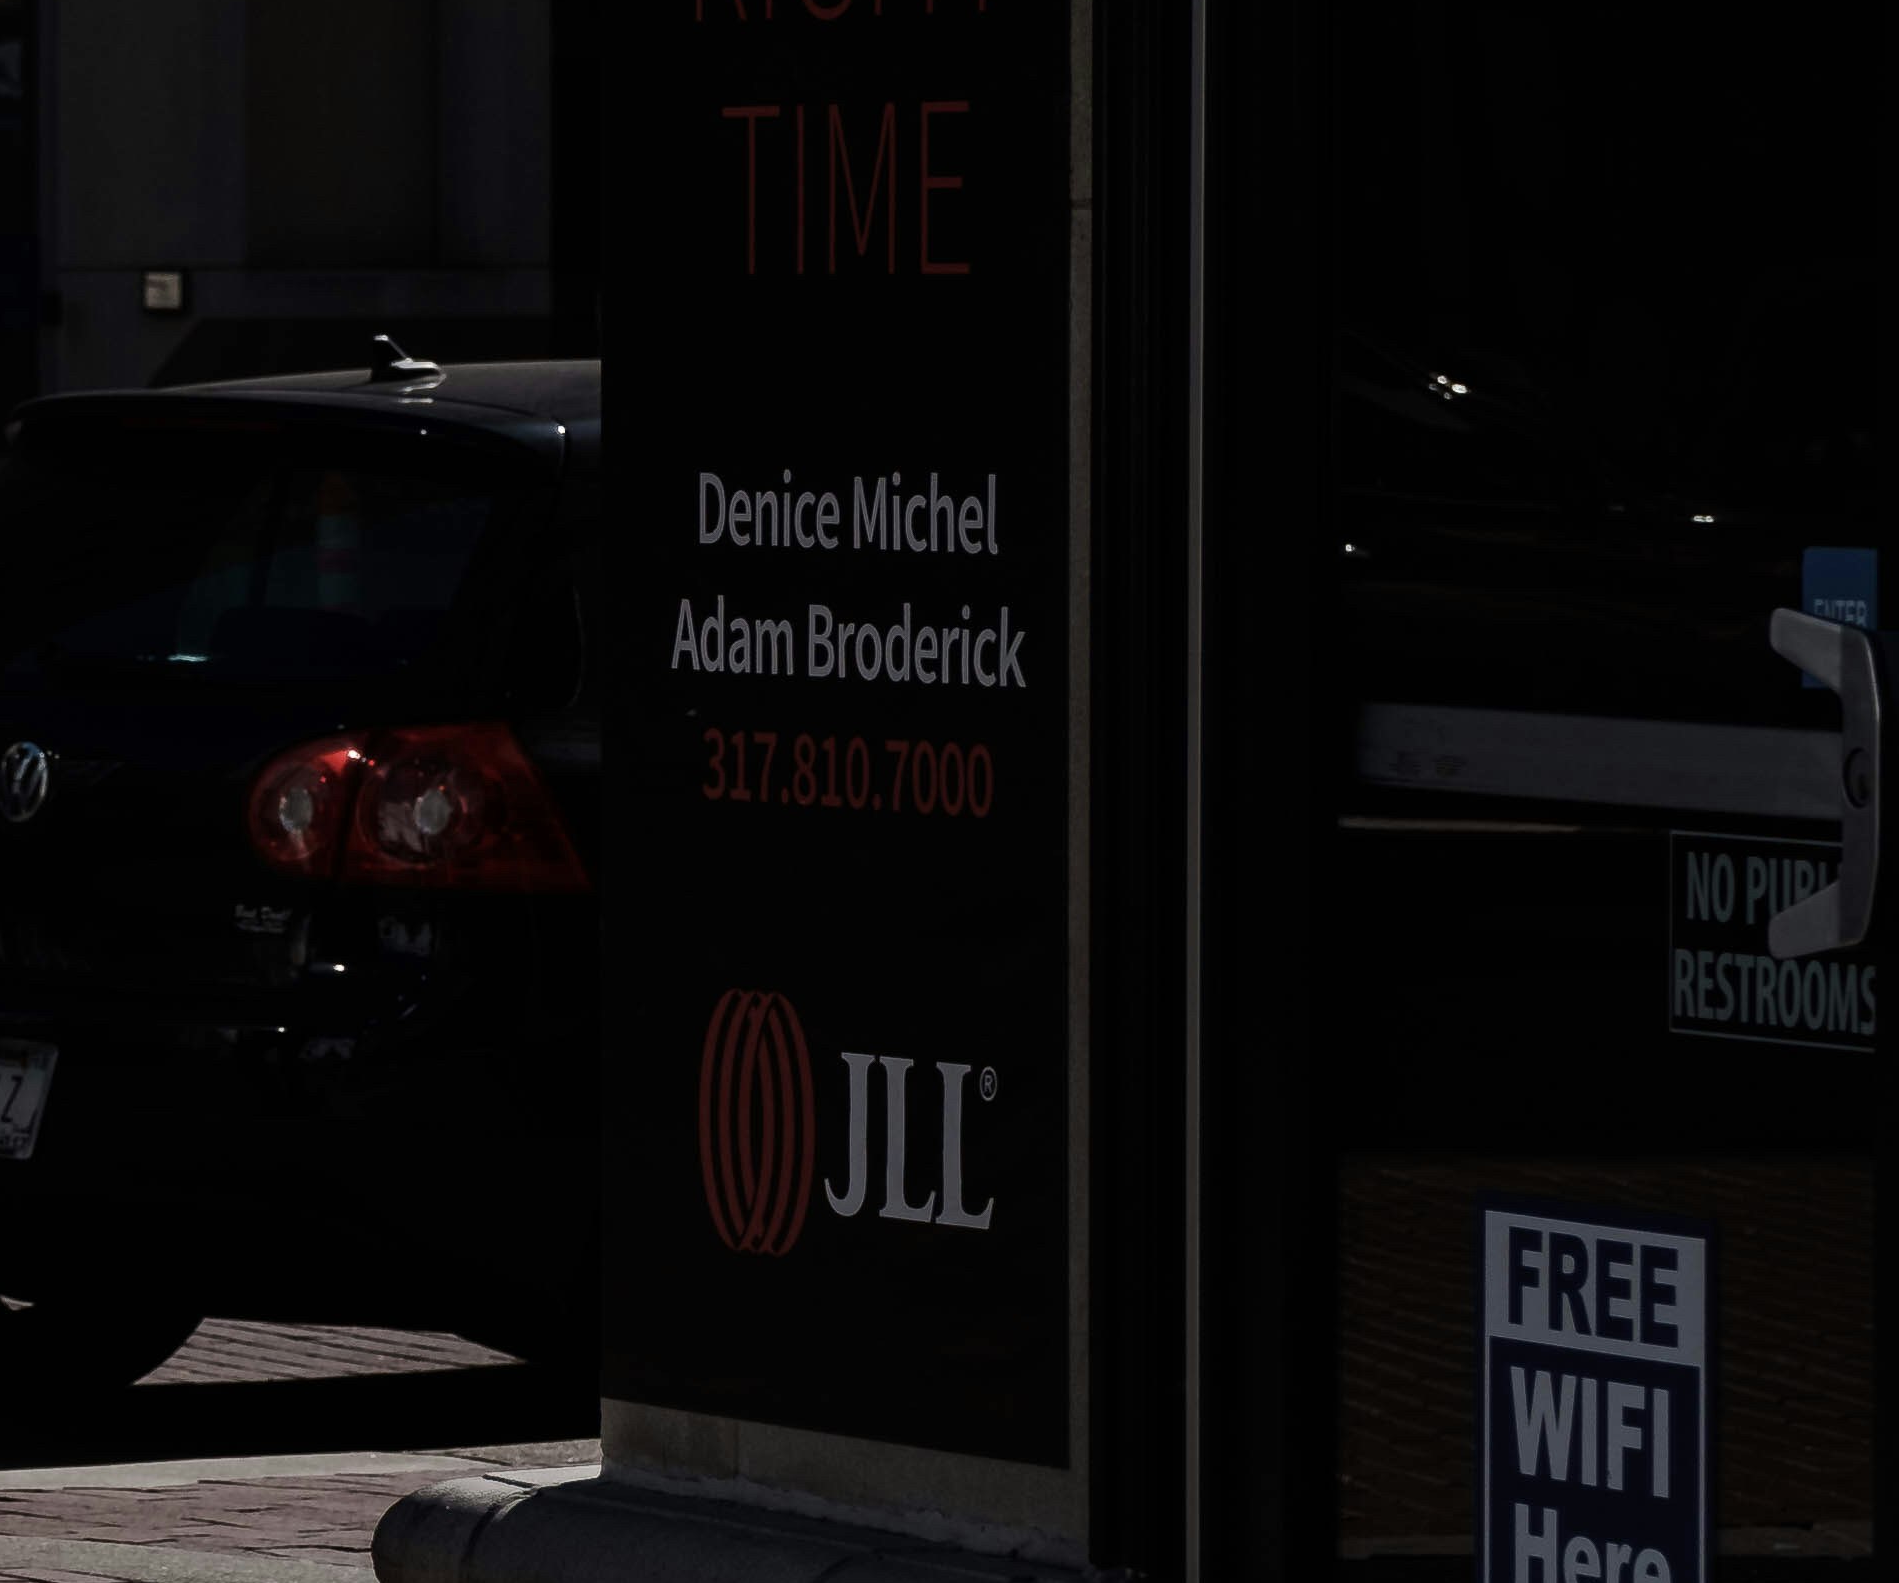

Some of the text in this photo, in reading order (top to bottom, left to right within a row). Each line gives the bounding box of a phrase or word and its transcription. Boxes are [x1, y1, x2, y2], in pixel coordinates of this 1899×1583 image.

[719, 99, 973, 275] TIME
[699, 468, 999, 555] Denice Michel
[670, 595, 1027, 689] Adam Broderick
[700, 726, 996, 818] 317.810.7000
[1686, 851, 1735, 924] NO
[1673, 947, 1877, 1036] RESTROOMS
[1508, 1225, 1679, 1348] FREE
[1509, 1364, 1671, 1500] WIFI
